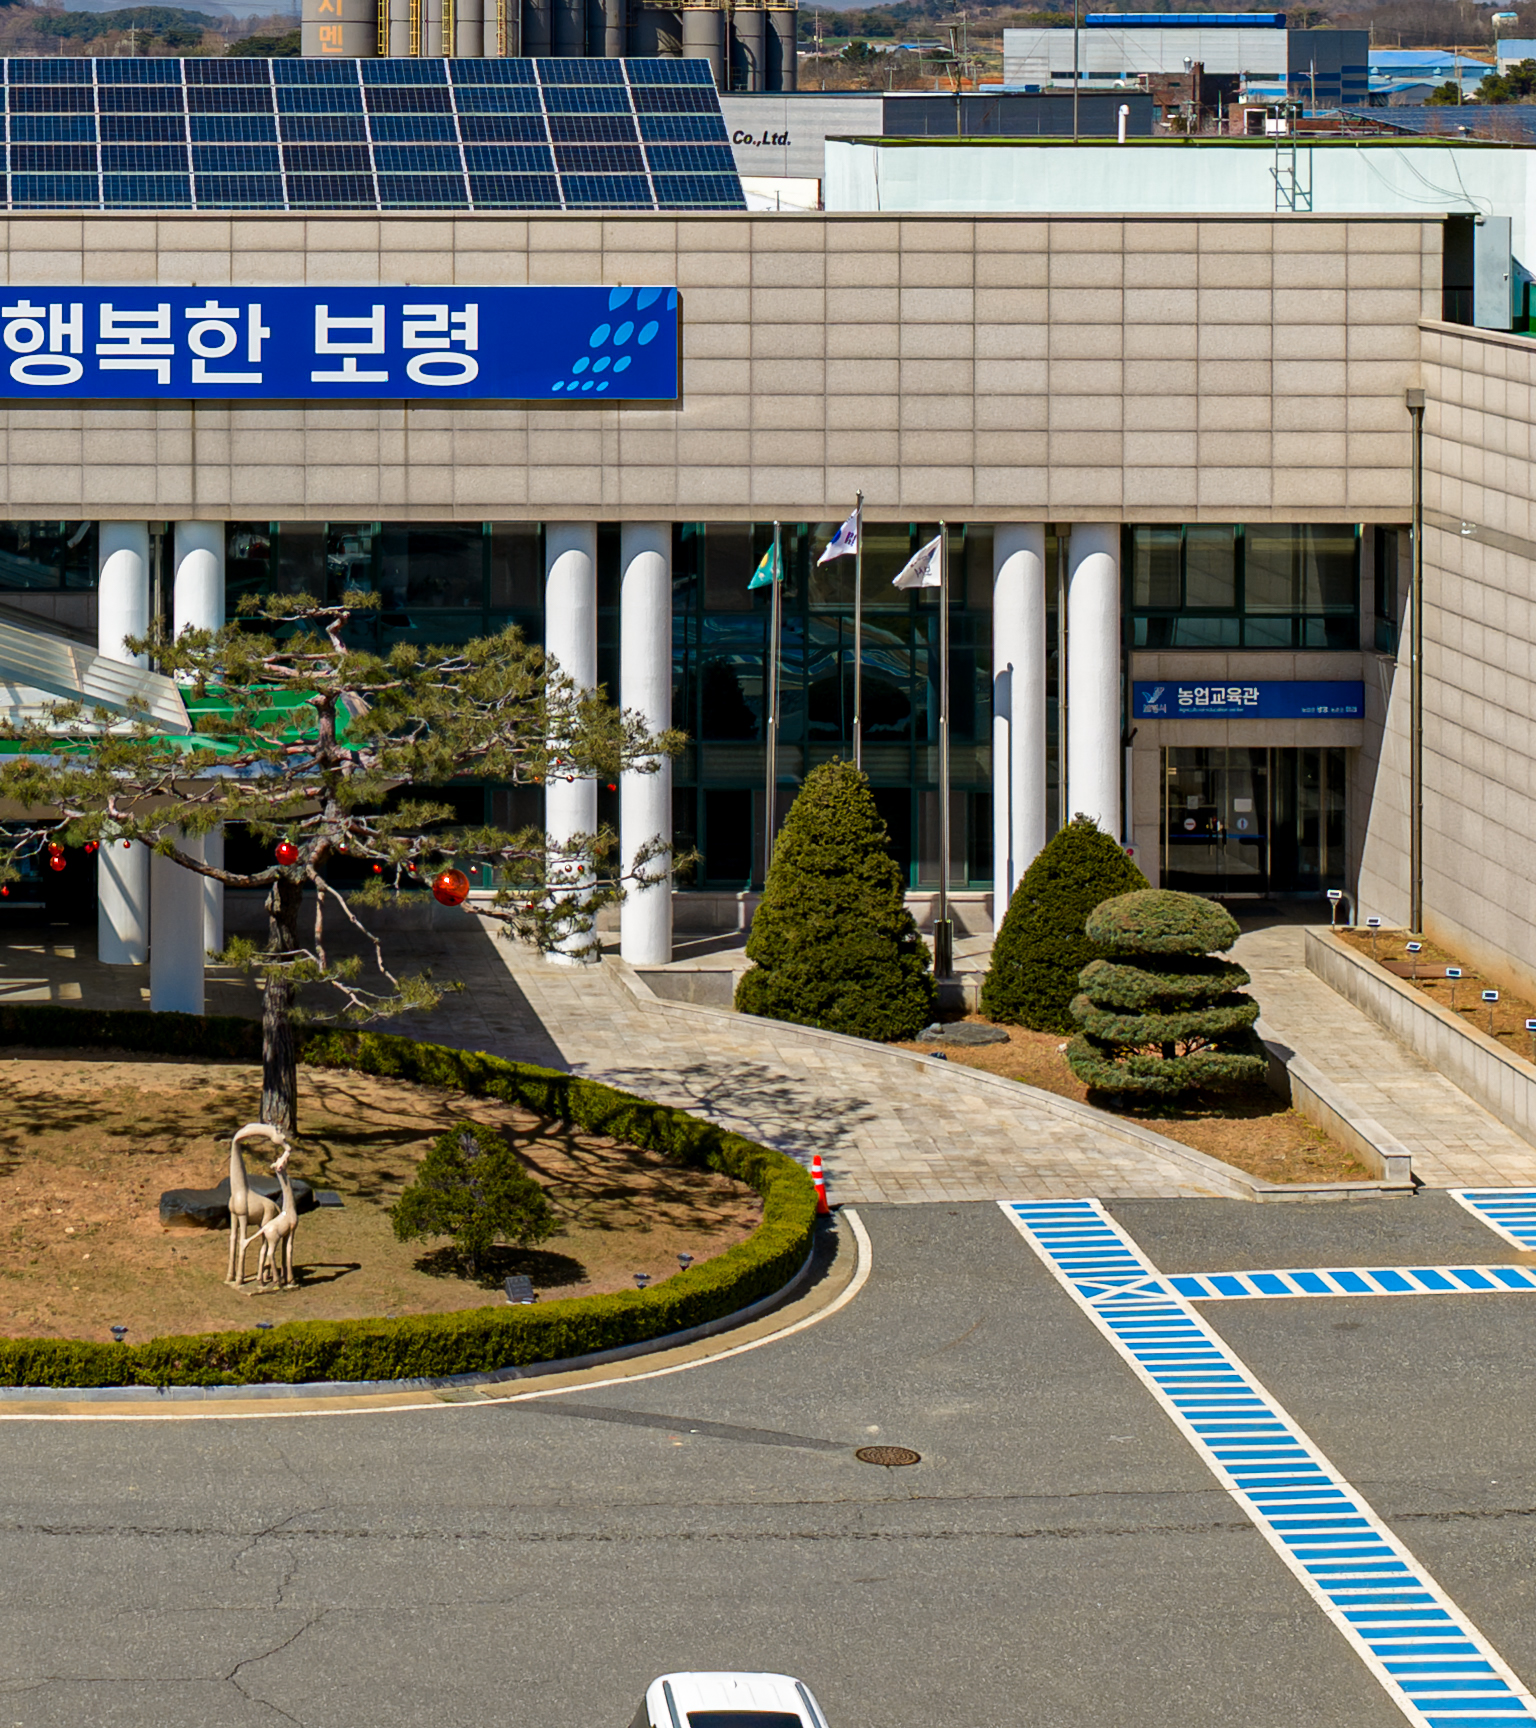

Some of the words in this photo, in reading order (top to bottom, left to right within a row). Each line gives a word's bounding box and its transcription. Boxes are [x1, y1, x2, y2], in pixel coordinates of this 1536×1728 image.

[732, 130, 792, 147] Co.,Ltd.
[0, 298, 271, 386] 행복한
[310, 302, 480, 387] 보령
[1177, 687, 1260, 706] 농업교육관
